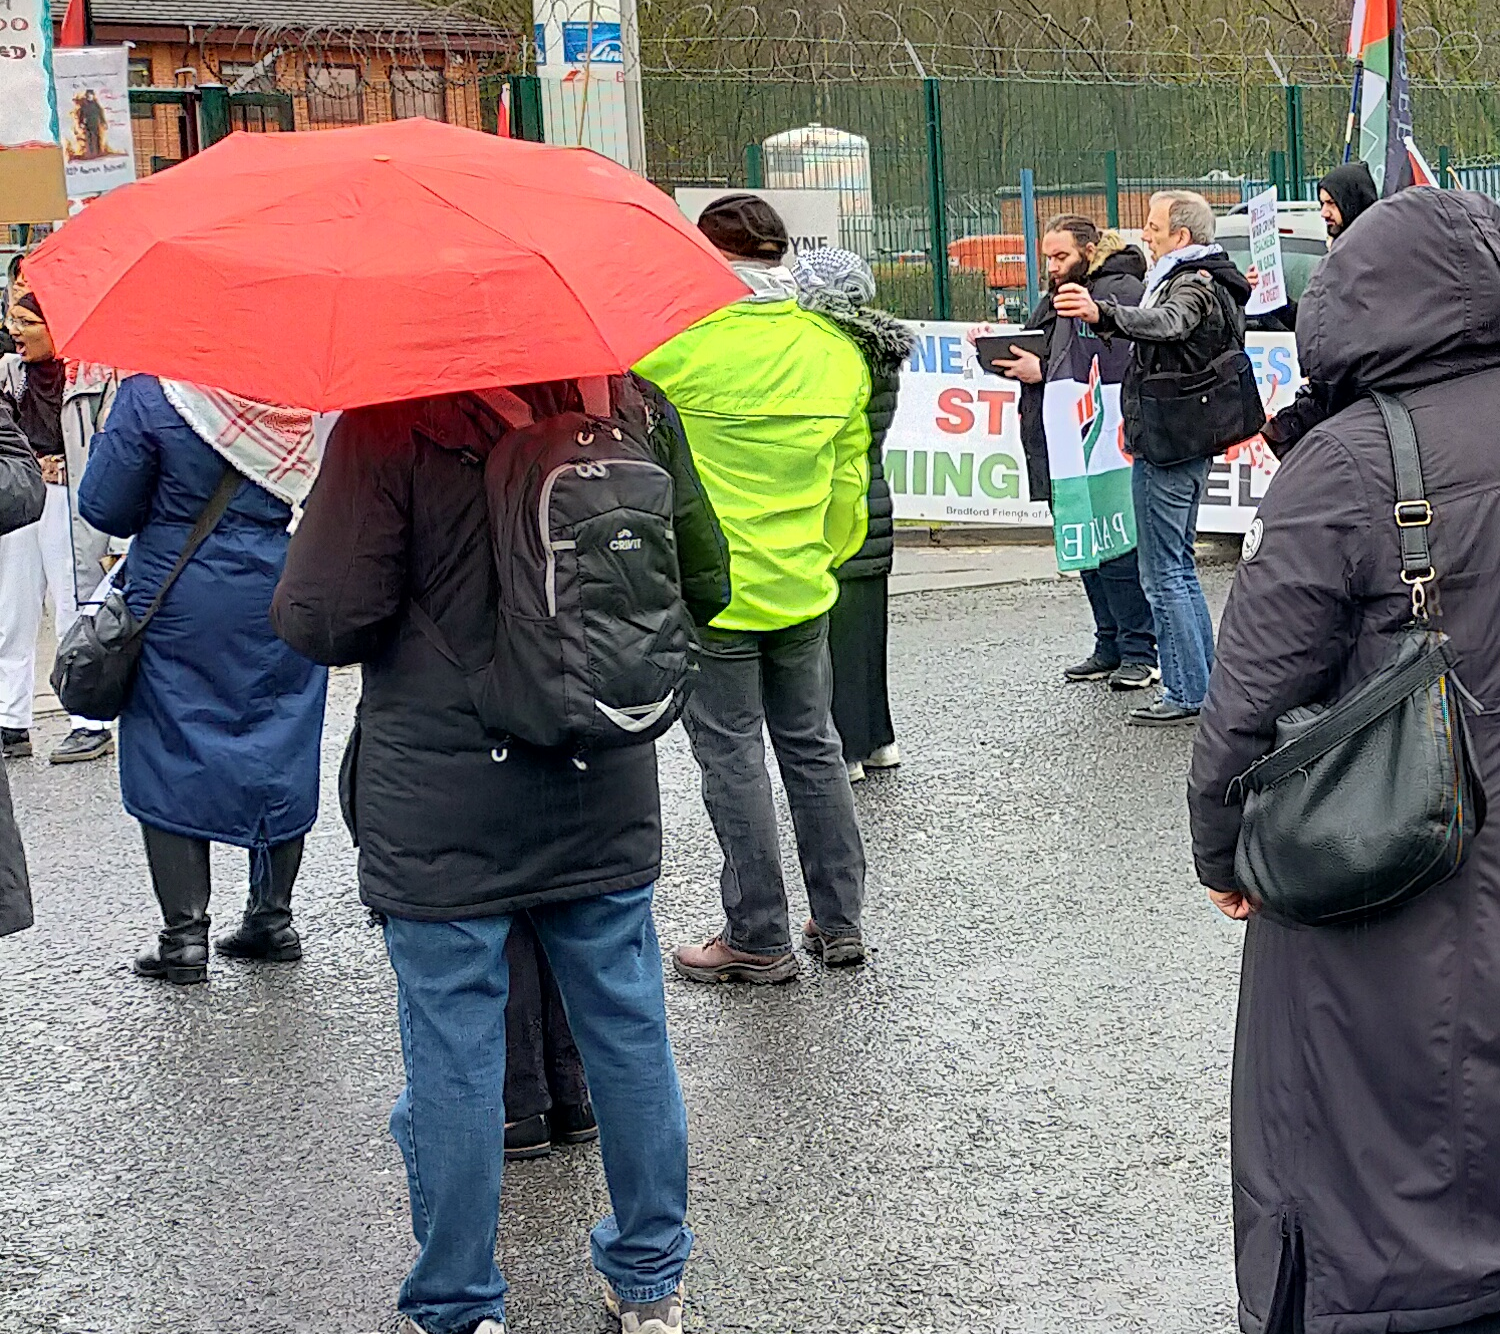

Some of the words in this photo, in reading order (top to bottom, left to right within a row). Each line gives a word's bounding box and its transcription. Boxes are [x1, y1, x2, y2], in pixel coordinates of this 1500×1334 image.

[946, 506, 990, 517] Bradford
[992, 508, 1029, 518] Friends
[1032, 510, 1042, 518] of
